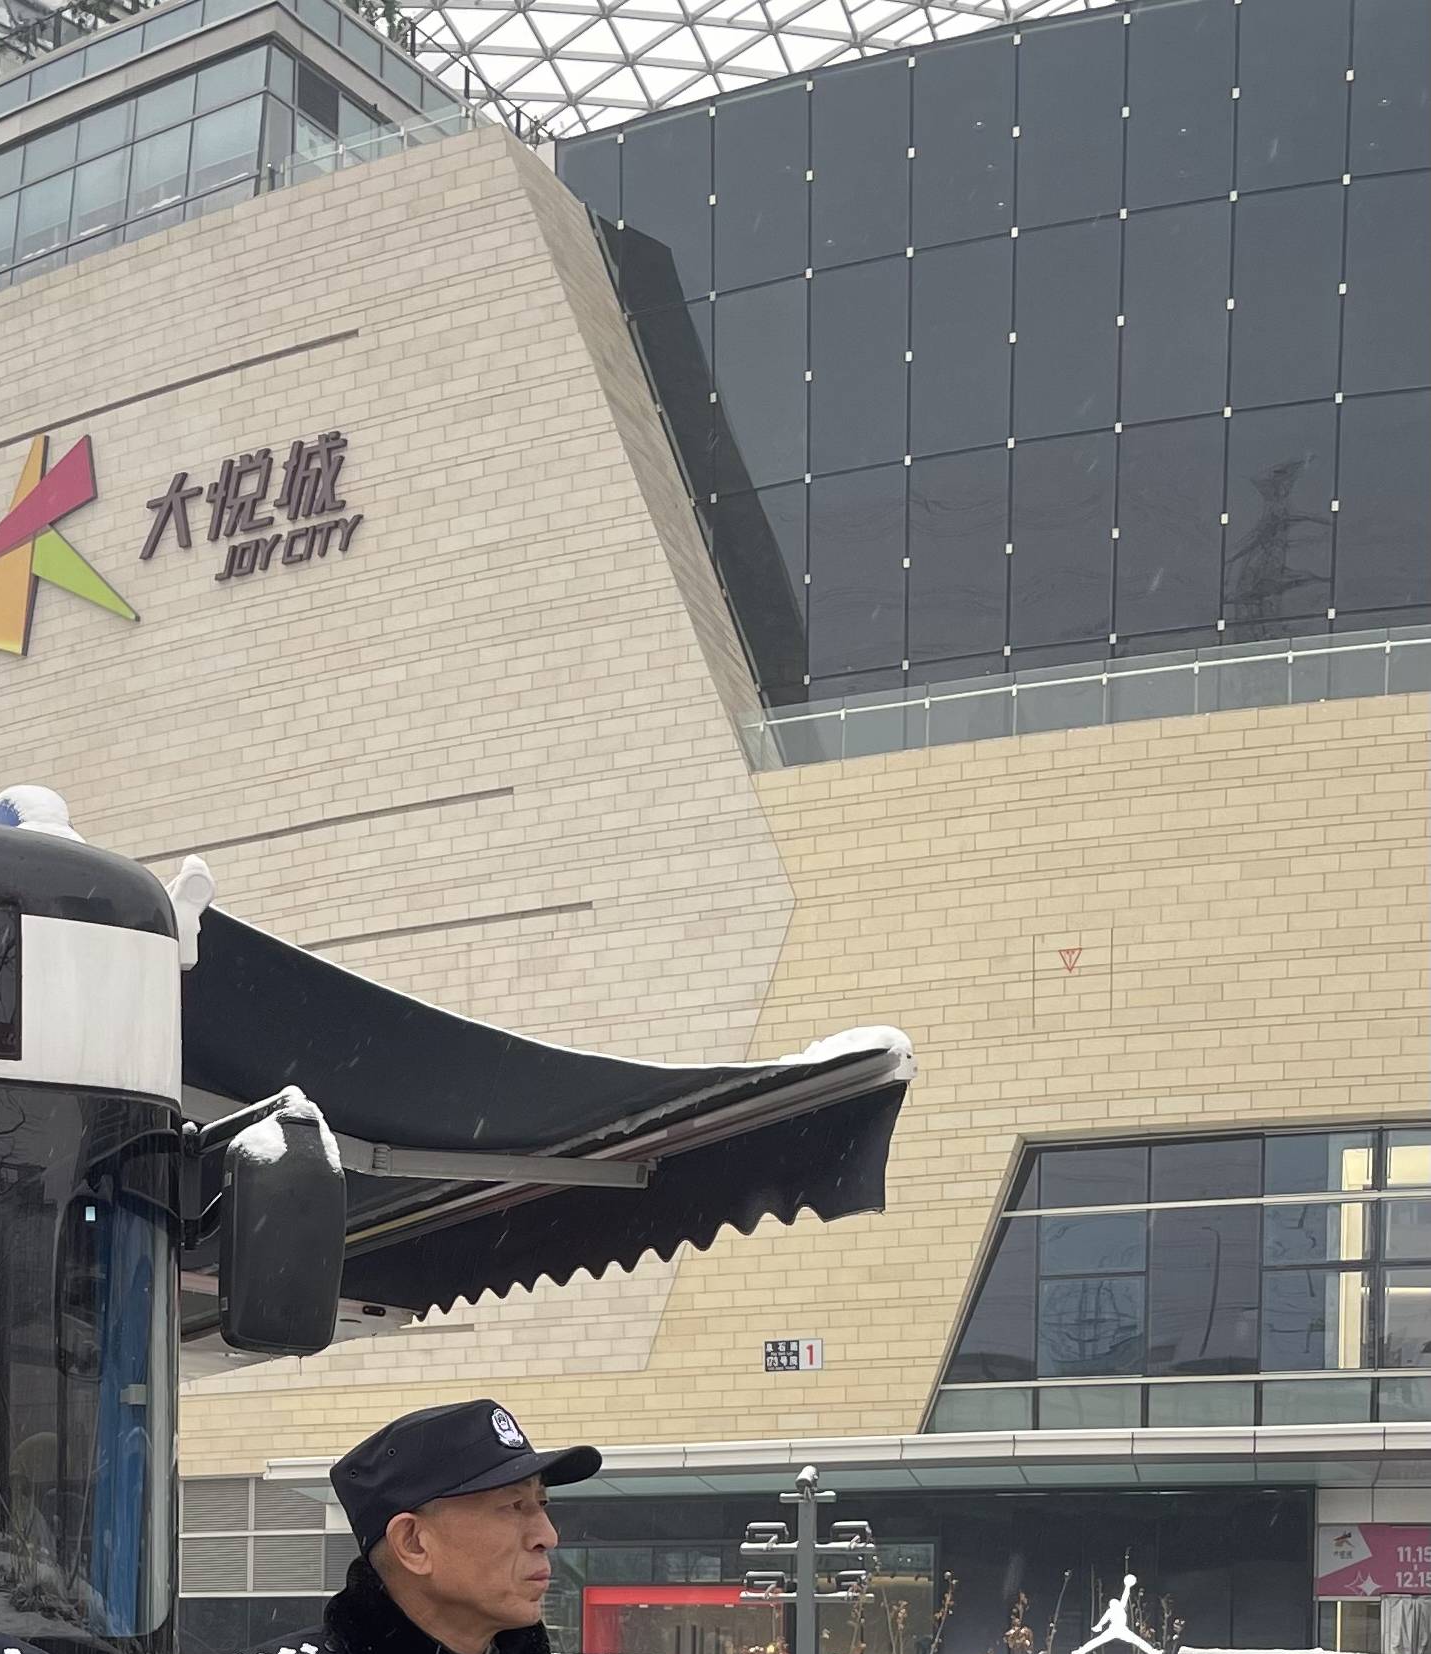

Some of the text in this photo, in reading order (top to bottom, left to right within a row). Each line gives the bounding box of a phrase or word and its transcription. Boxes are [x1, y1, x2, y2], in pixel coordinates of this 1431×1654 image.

[138, 430, 349, 561] 大悦城
[214, 512, 364, 582] JOY CITY
[805, 1344, 814, 1366] 1
